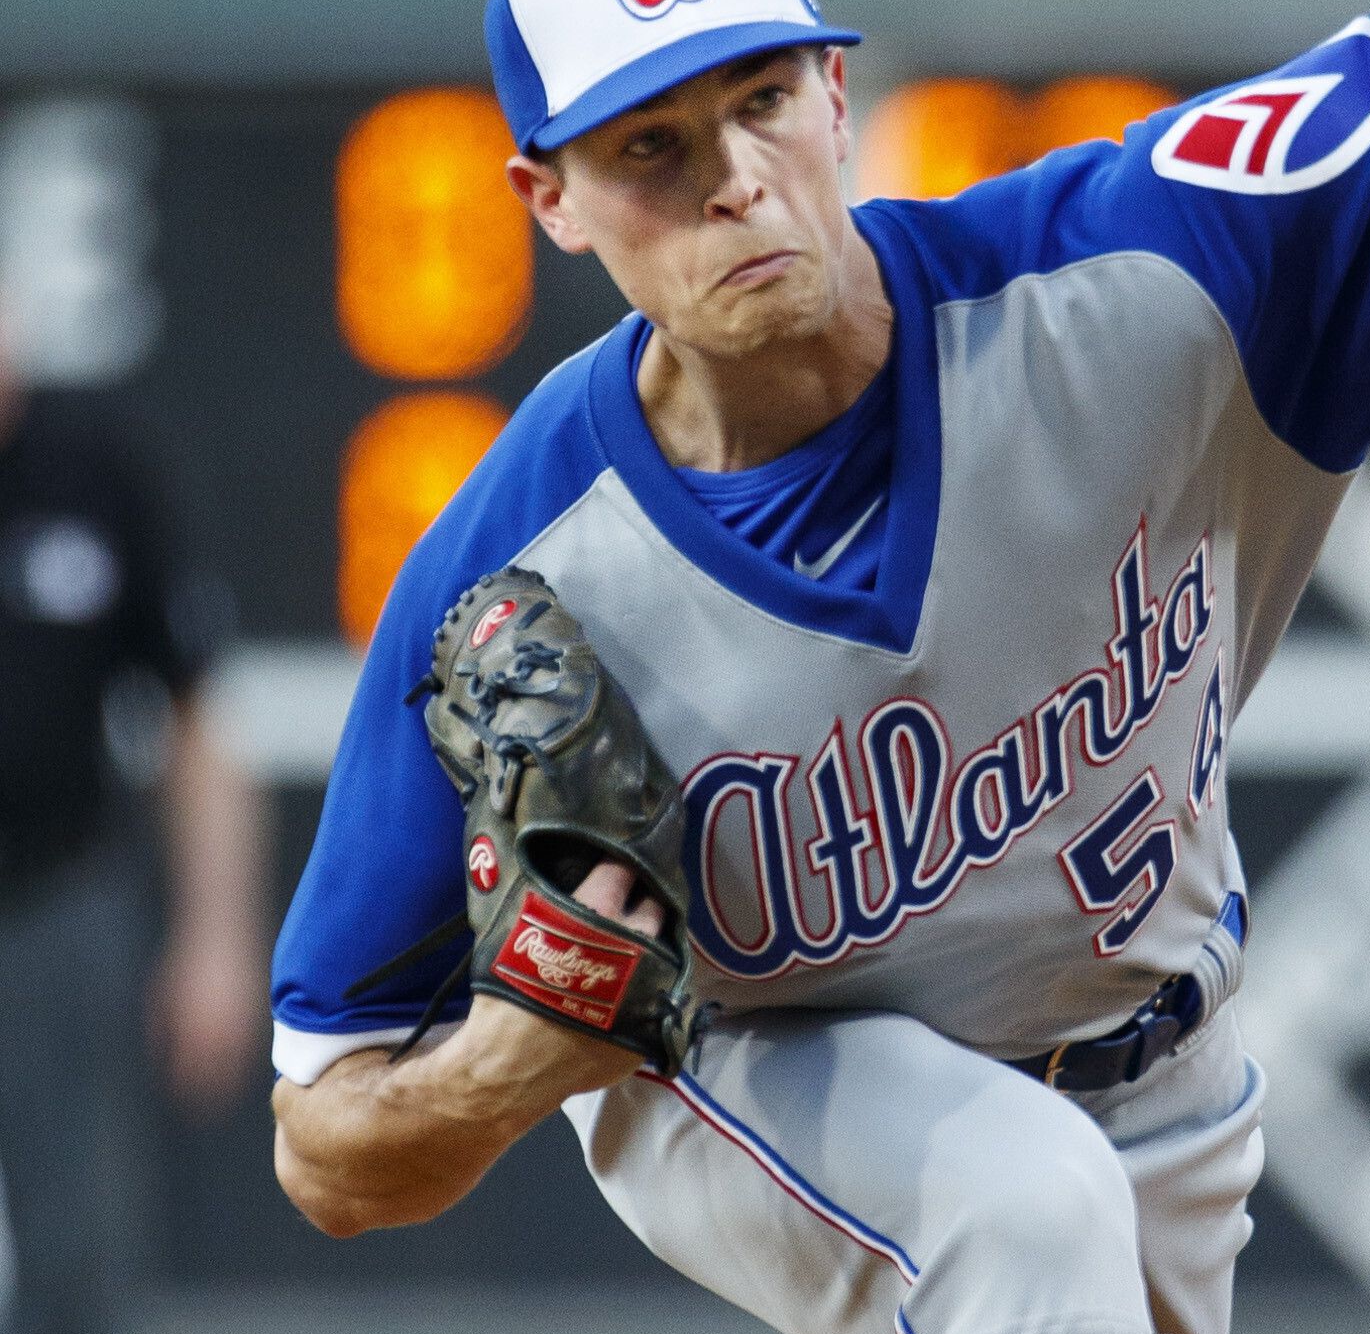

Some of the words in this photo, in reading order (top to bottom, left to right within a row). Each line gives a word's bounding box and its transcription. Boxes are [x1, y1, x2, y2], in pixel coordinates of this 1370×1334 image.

[682, 513, 1214, 980] Atlanta
[1057, 641, 1225, 957] 54
[513, 926, 618, 991] Rawlings
